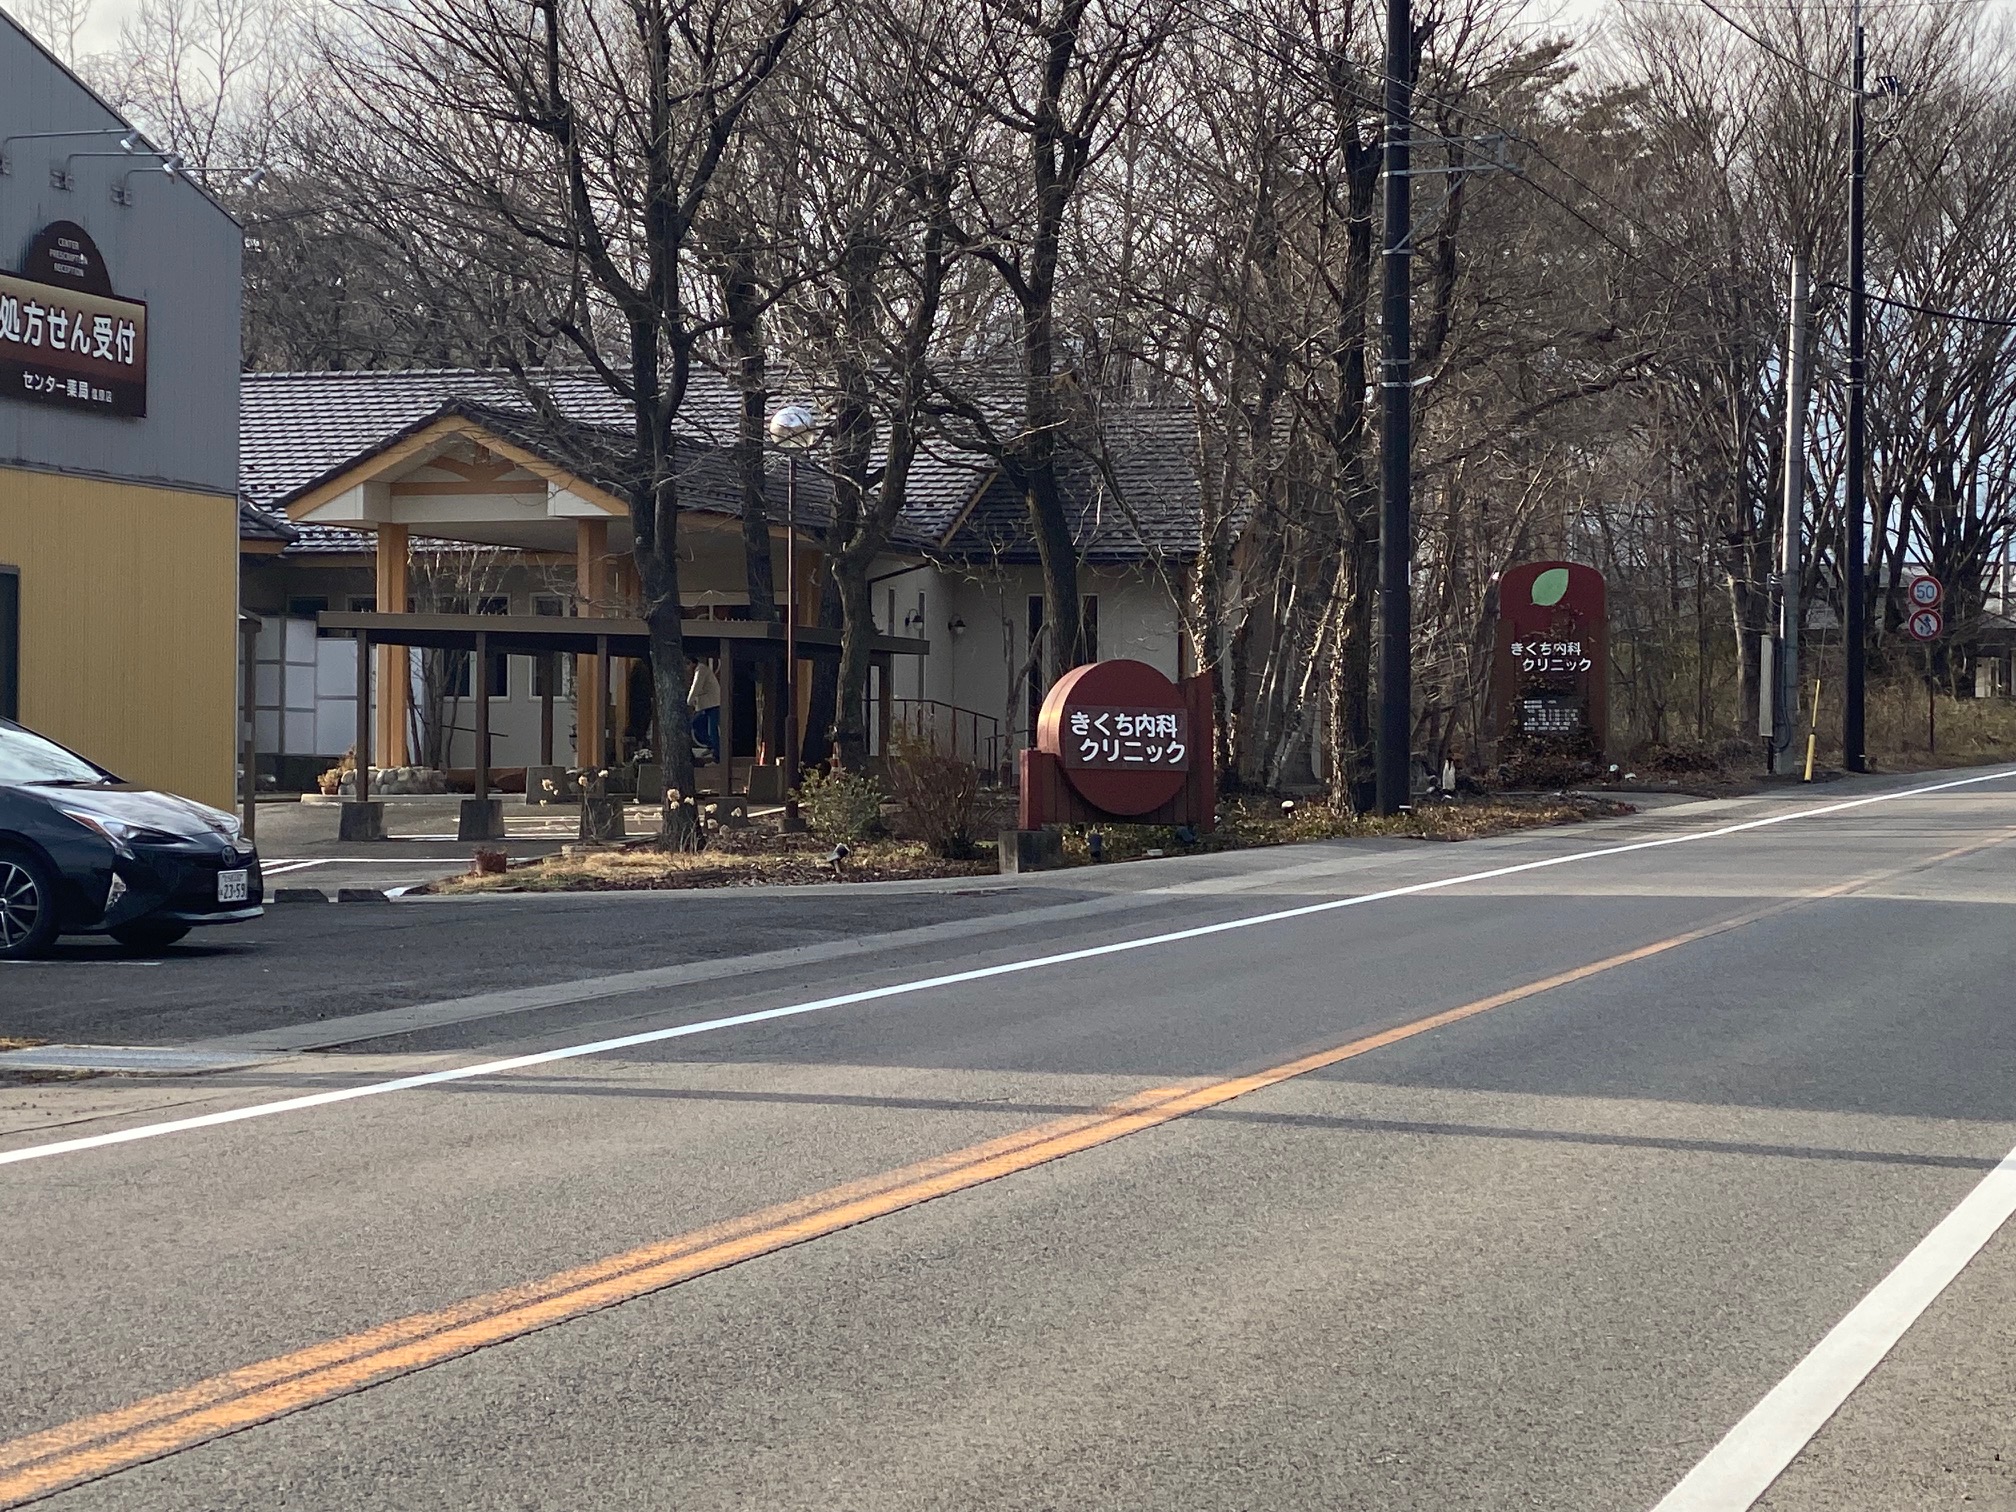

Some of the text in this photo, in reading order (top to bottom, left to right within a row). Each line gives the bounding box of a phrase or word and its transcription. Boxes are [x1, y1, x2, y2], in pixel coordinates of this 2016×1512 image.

[0, 295, 136, 365] 処方せん受付
[23, 370, 89, 400] センター薬局
[1916, 584, 1935, 599] 50
[1510, 641, 1581, 656] きくち内科
[1522, 658, 1592, 672] クリニック
[1070, 711, 1178, 739] きくち内科
[1079, 738, 1186, 764] クリニック
